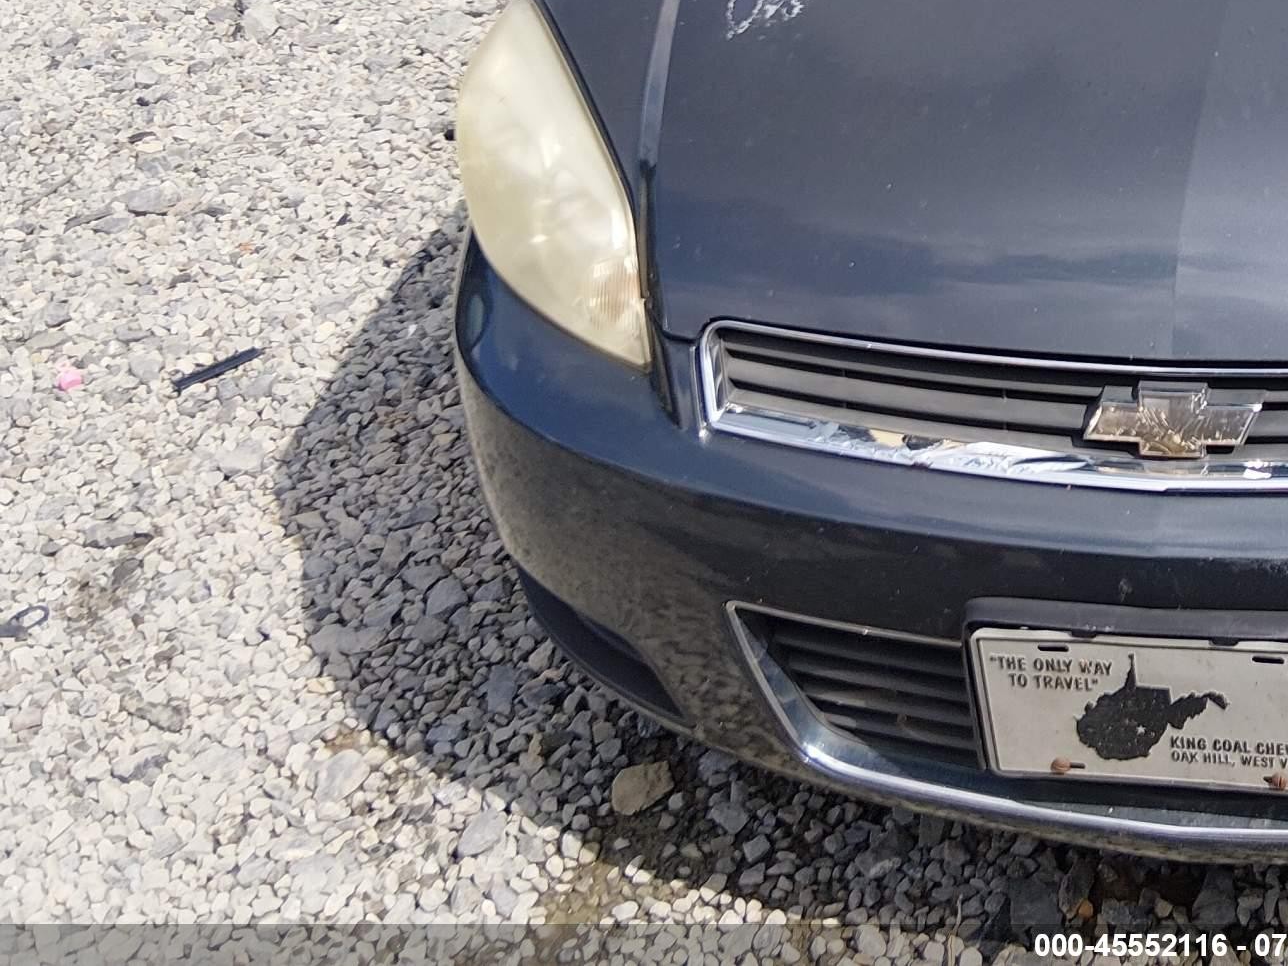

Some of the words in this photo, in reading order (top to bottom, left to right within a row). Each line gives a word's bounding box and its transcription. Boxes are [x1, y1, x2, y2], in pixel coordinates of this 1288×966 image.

[1033, 657, 1072, 674] ONLY
[1078, 659, 1113, 676] WAY
[1008, 672, 1028, 688] TO
[1170, 736, 1207, 751] KING
[1212, 738, 1251, 754] COAL
[1171, 749, 1198, 764] OAK
[1203, 753, 1236, 767] HILL,
[1240, 754, 1274, 769] WEST
